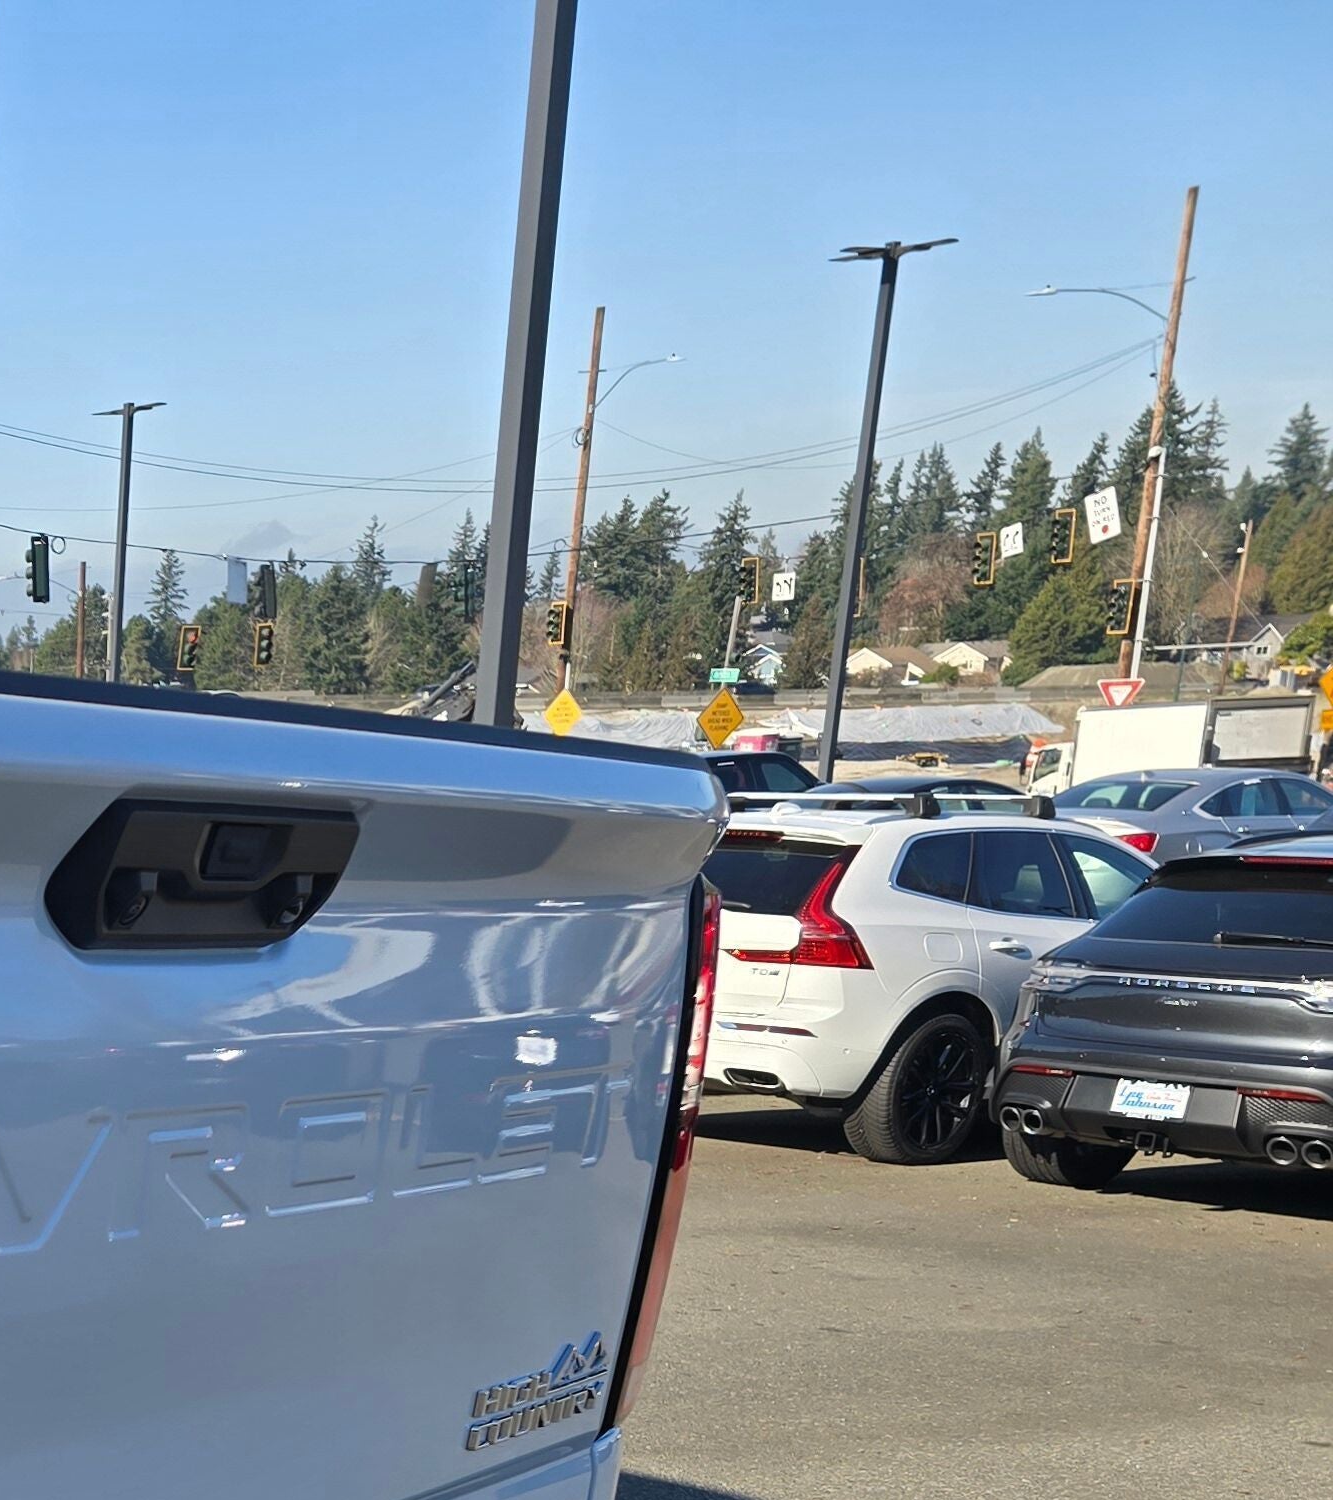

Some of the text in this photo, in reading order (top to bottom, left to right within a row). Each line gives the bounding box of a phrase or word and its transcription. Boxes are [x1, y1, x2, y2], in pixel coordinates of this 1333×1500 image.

[1093, 495, 1108, 507] NO
[1117, 1091, 1175, 1111] Johnson
[472, 1368, 553, 1418] HIGH
[464, 1381, 605, 1451] COUNTRY
